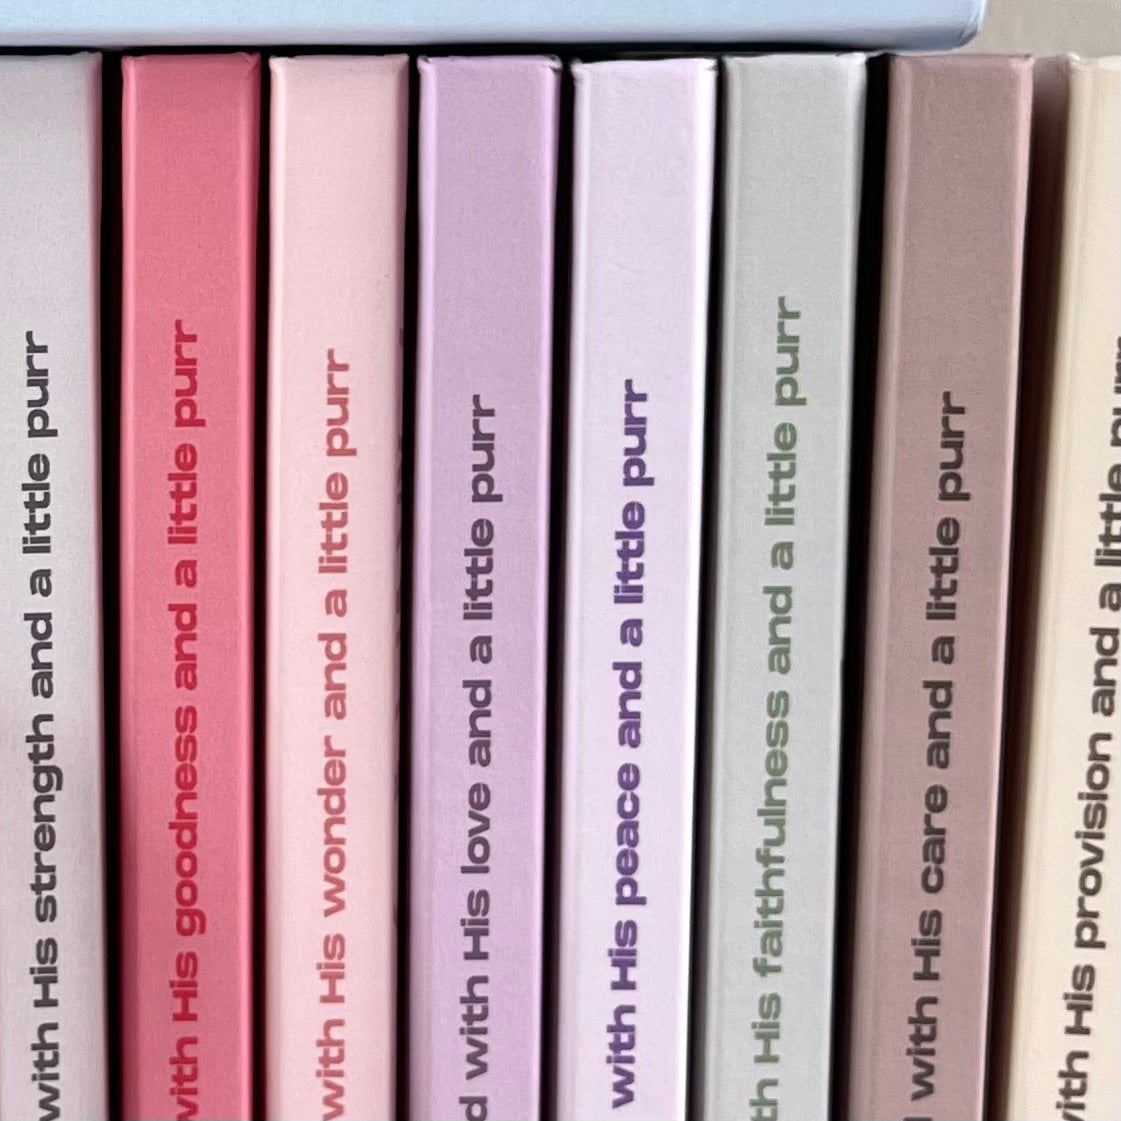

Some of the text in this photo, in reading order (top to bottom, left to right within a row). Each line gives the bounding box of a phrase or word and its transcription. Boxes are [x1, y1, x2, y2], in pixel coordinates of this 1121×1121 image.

[174, 318, 207, 428] purr
[167, 442, 198, 545] little
[471, 393, 504, 503] purr
[938, 390, 972, 502] purr
[174, 559, 198, 589] a
[462, 518, 495, 621] little
[925, 516, 961, 621] little
[1098, 582, 1121, 613] a
[167, 603, 198, 691] and
[469, 635, 493, 665] a
[931, 635, 956, 666] a
[1088, 626, 1119, 718] and
[21, 330, 64, 1121] with His strength and a little purr
[315, 348, 358, 1121] with His wonder and a little purr
[462, 679, 493, 768] and
[605, 378, 655, 1110] with His peace and a little purr
[748, 295, 808, 1121] th His faithfulness and a little purr
[922, 680, 954, 770] and
[167, 705, 207, 937] goodness
[460, 782, 492, 875] love
[920, 784, 949, 895] care
[1074, 732, 1113, 950] provision
[459, 888, 491, 961] His
[910, 909, 943, 982] His
[168, 951, 199, 1022] His
[458, 975, 490, 1081] with
[1062, 964, 1096, 1036] His
[905, 995, 939, 1102] with
[1055, 1050, 1090, 1121] ith
